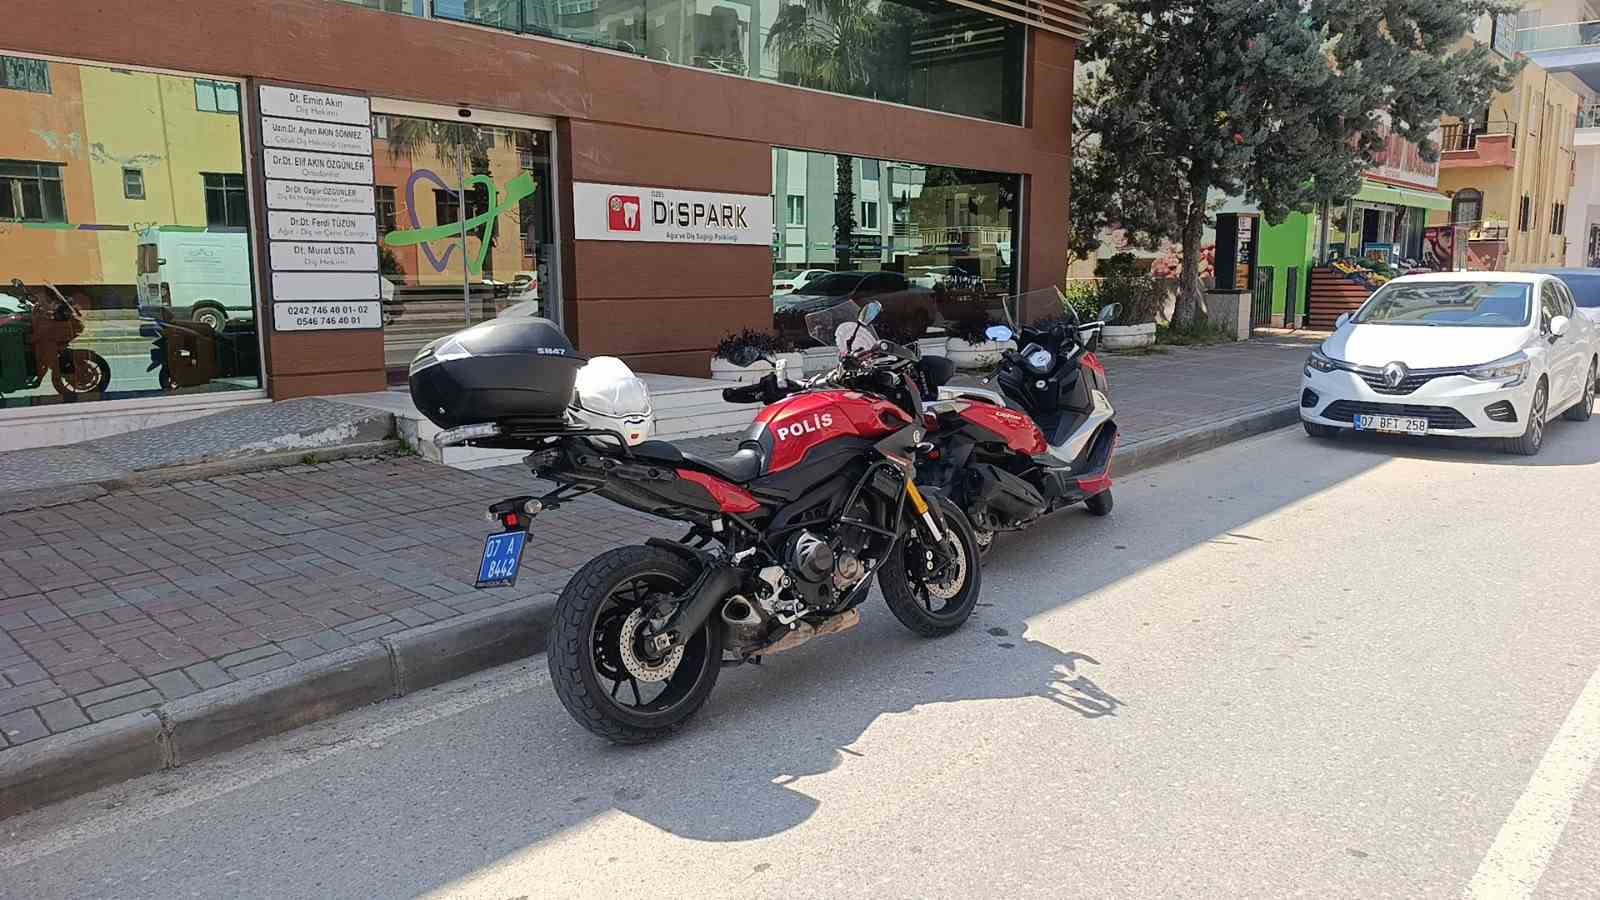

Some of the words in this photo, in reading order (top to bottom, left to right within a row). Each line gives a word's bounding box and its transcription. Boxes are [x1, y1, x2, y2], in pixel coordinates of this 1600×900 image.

[289, 92, 301, 104] Dt.
[303, 94, 324, 106] Emin
[307, 158, 325, 169] AKIN
[293, 246, 306, 255] Dt.
[308, 246, 332, 256] Murat
[333, 246, 356, 255] USTA
[287, 306, 310, 316] 0242
[311, 305, 328, 315] 746
[329, 305, 341, 314] 40
[320, 316, 337, 325] 746
[338, 316, 350, 325] 40
[350, 316, 361, 324] 01
[776, 412, 834, 442] POLİS
[1361, 416, 1374, 428] 07
[1406, 418, 1425, 431] 258
[486, 538, 502, 559] 07
[506, 536, 515, 555] A
[487, 557, 516, 579] 8442
